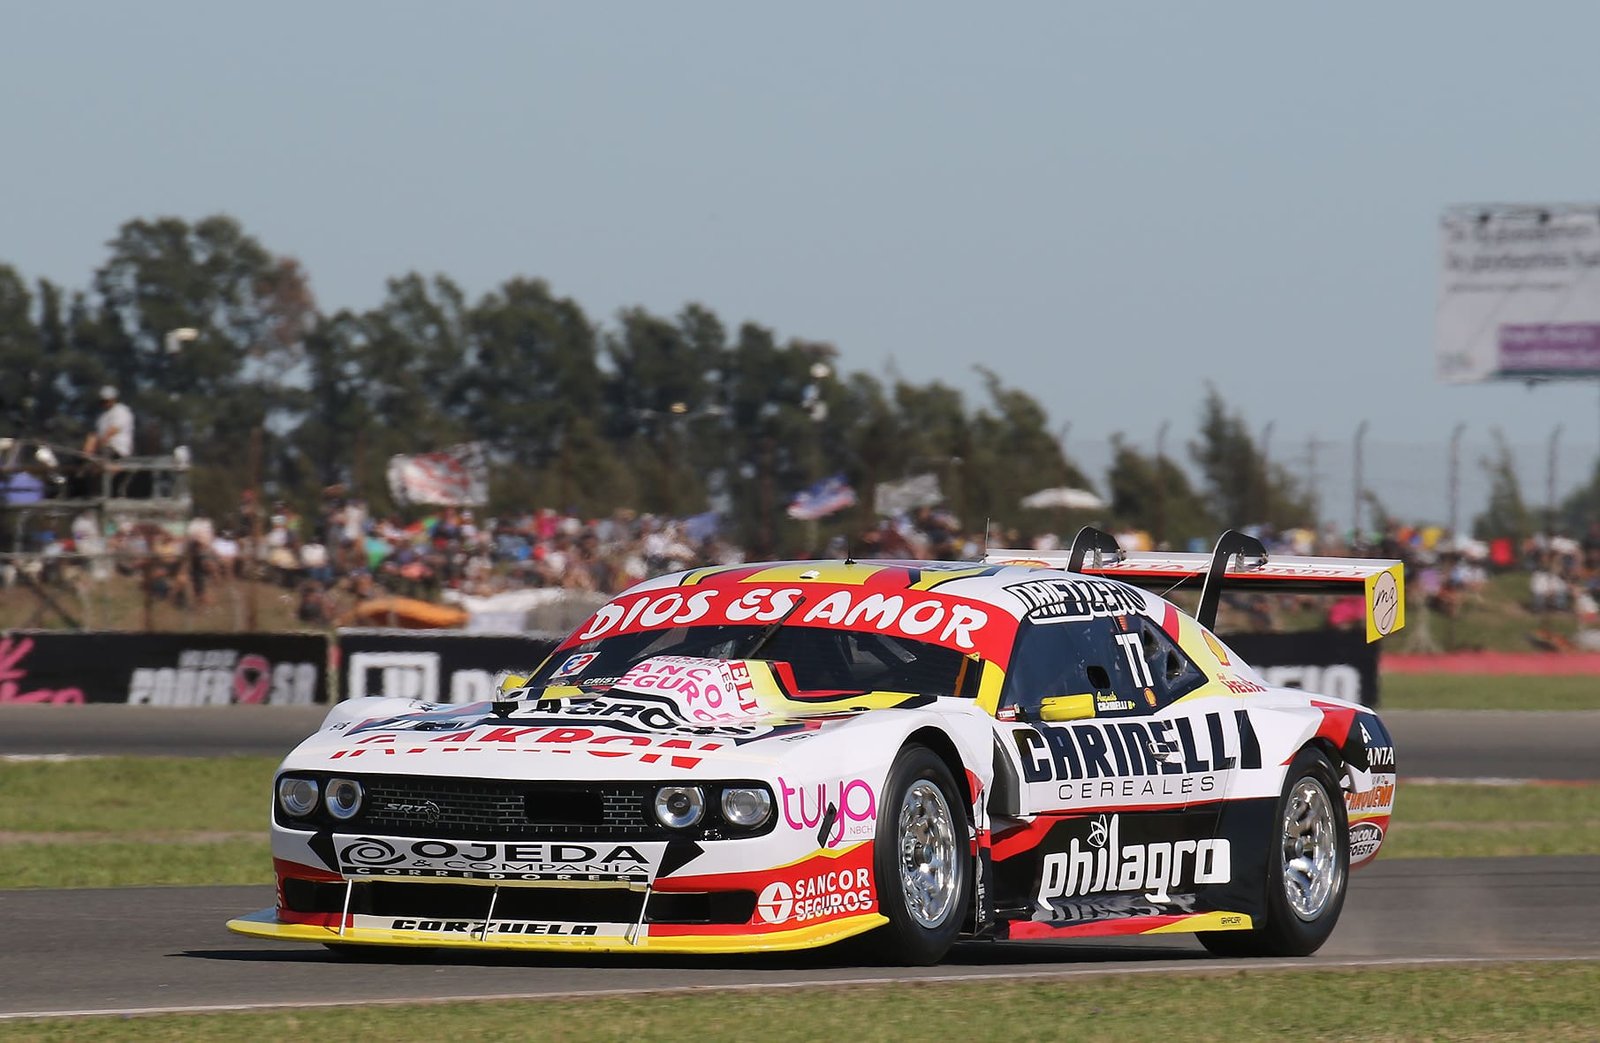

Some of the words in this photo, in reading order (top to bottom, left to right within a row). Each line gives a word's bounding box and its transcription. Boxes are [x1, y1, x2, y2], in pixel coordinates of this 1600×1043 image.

[579, 589, 720, 640] DIOS
[725, 588, 803, 621] ES
[803, 590, 989, 649] AMOR
[1012, 709, 1262, 784] CARINELLI
[1058, 776, 1216, 800] CEREALES
[383, 803, 427, 814] SRT
[777, 776, 876, 848] tuya
[849, 825, 873, 835] NBCH
[410, 841, 650, 864] OJEDA
[412, 859, 433, 868] &
[1037, 813, 1231, 911] philagro
[356, 867, 631, 880] CORREDORES
[795, 868, 871, 900] SANCOR
[794, 889, 873, 921] SEGUROS
[391, 919, 598, 936] CORZUELA
